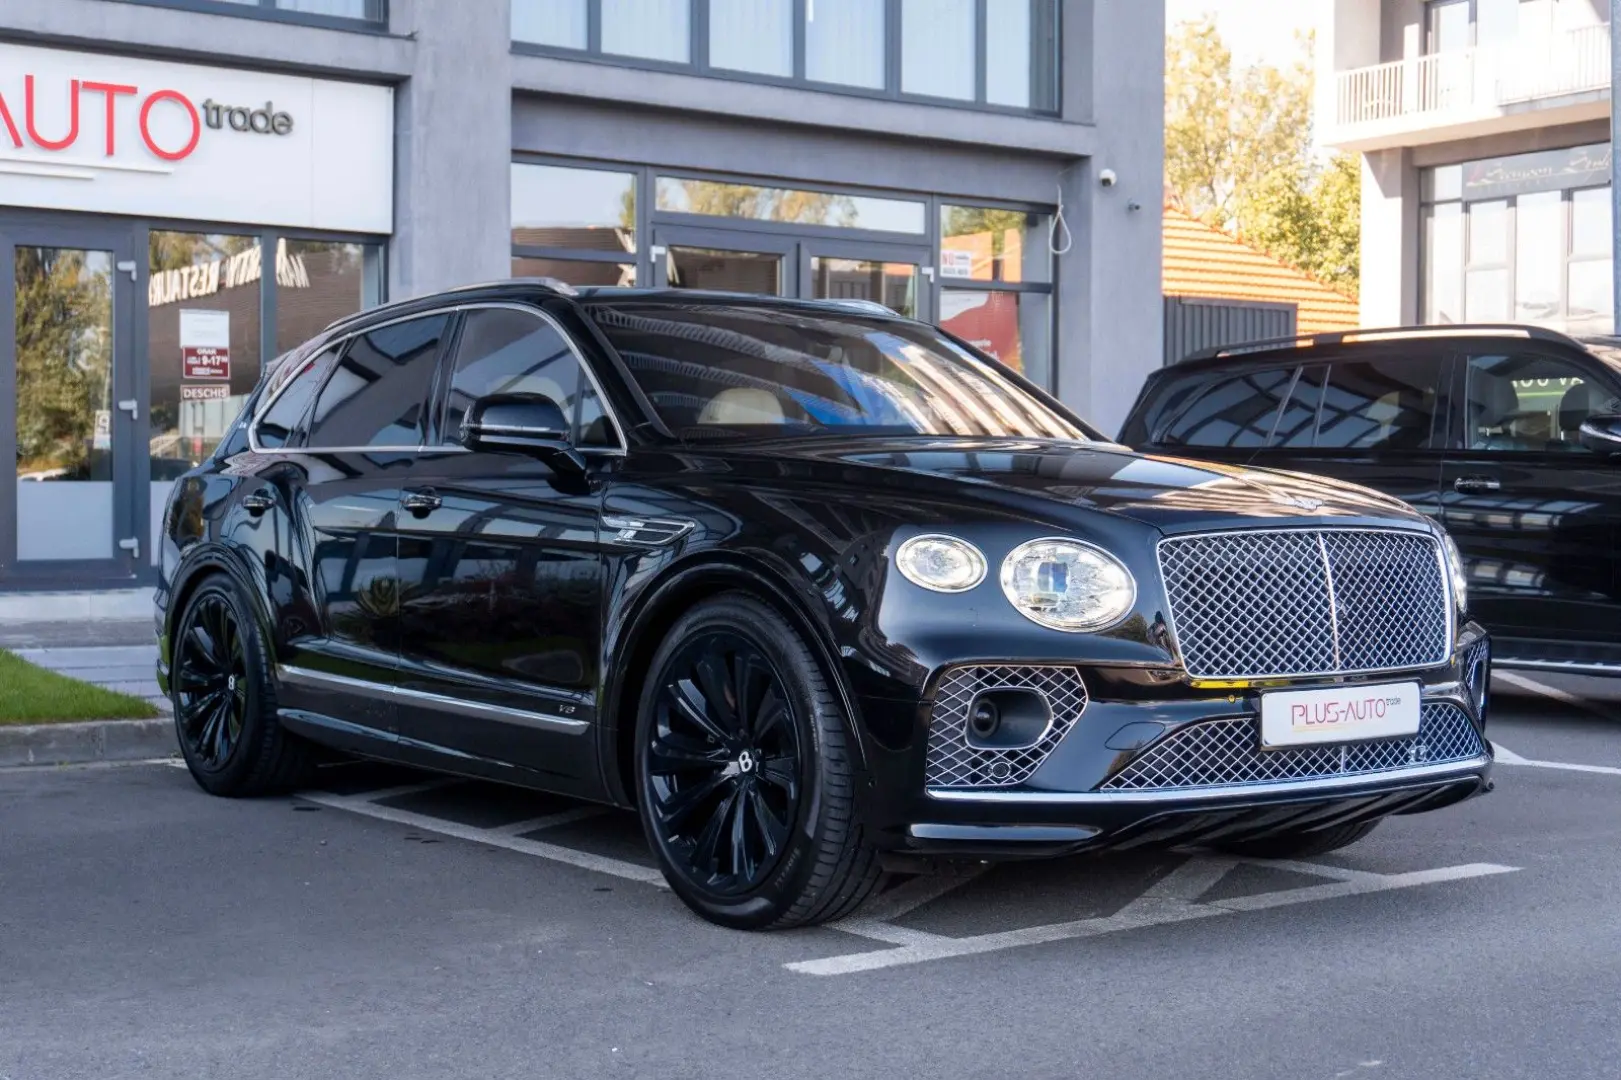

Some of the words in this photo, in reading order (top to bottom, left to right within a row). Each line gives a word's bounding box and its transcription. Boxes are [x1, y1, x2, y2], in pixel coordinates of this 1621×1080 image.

[202, 99, 294, 136] trade
[183, 388, 228, 399] DESCHIS
[1292, 698, 1386, 726] PLUS-AUTO
